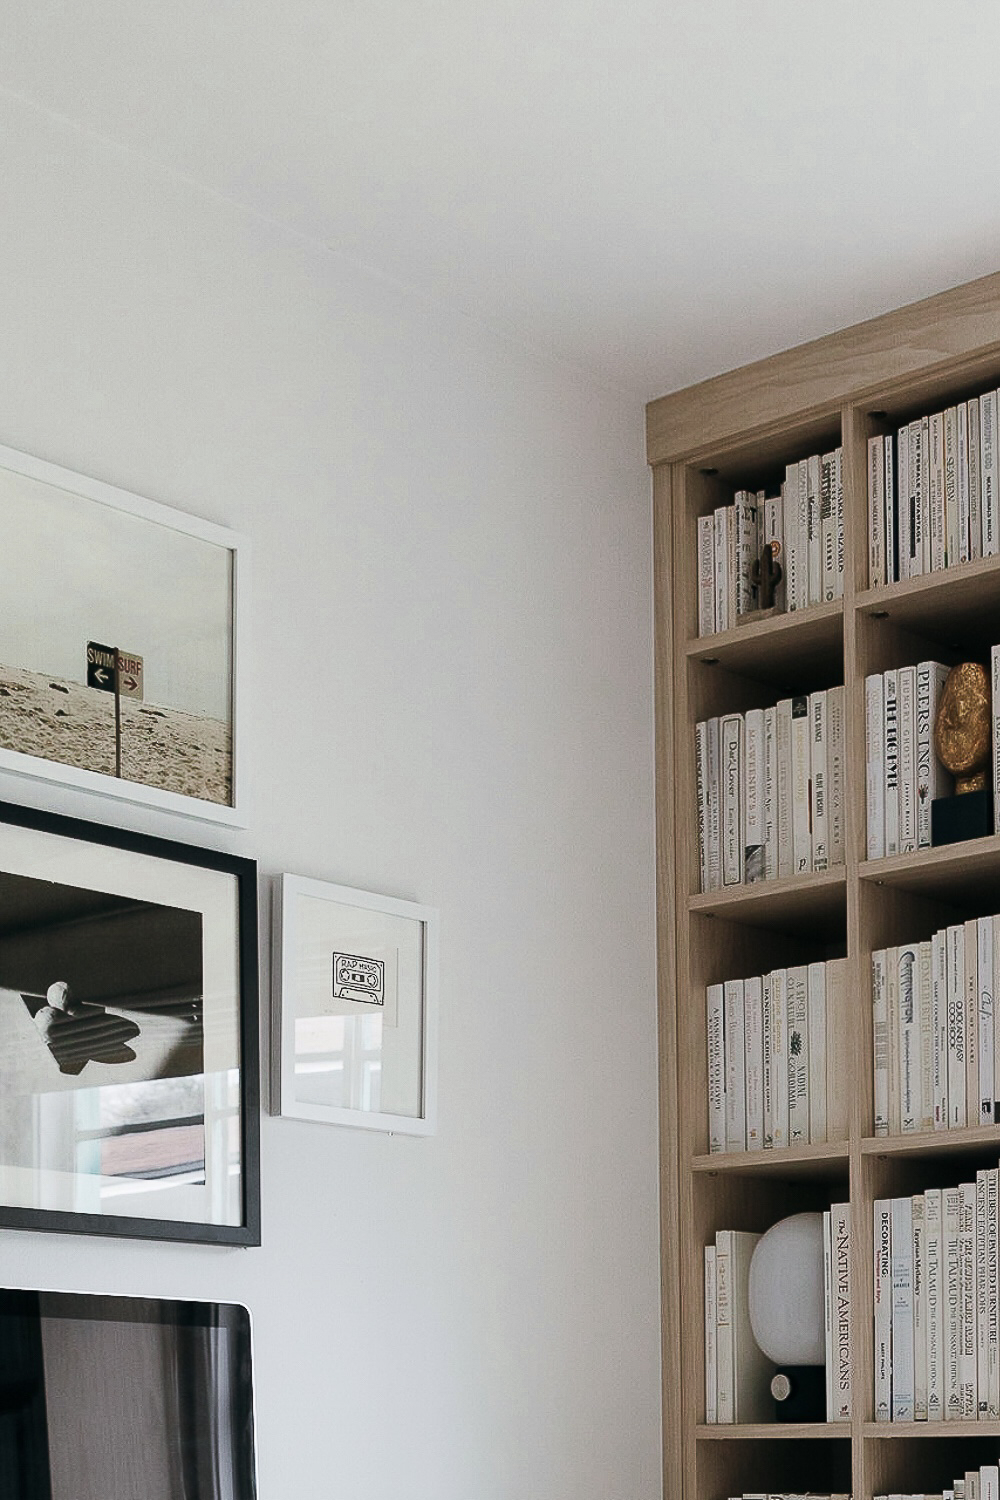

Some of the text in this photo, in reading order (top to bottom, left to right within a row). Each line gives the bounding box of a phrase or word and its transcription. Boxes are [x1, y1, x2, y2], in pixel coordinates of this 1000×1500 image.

[87, 648, 115, 668] SWIM
[118, 657, 141, 675] SURF
[887, 699, 897, 725] THE
[918, 670, 930, 778] PEERS INC
[887, 728, 897, 752] BIG
[341, 959, 377, 973] RAP MUSIC
[796, 990, 805, 1022] SPORT
[955, 1001, 963, 1025] QUICK
[715, 1061, 721, 1077] TO
[956, 1044, 964, 1063] EASY
[797, 1065, 806, 1098] NADINE
[978, 1178, 986, 1218] ANCIENT
[988, 1176, 997, 1200] THE
[881, 1212, 889, 1278] DECORATING:
[978, 1220, 986, 1265] EGYPTIAN
[837, 1236, 848, 1293] NATIVE
[912, 1228, 922, 1296] Egyptian Mythology
[989, 1239, 997, 1284] PAINTED
[989, 1285, 997, 1344] FURNITURE
[838, 1296, 849, 1390] AMERICANS
